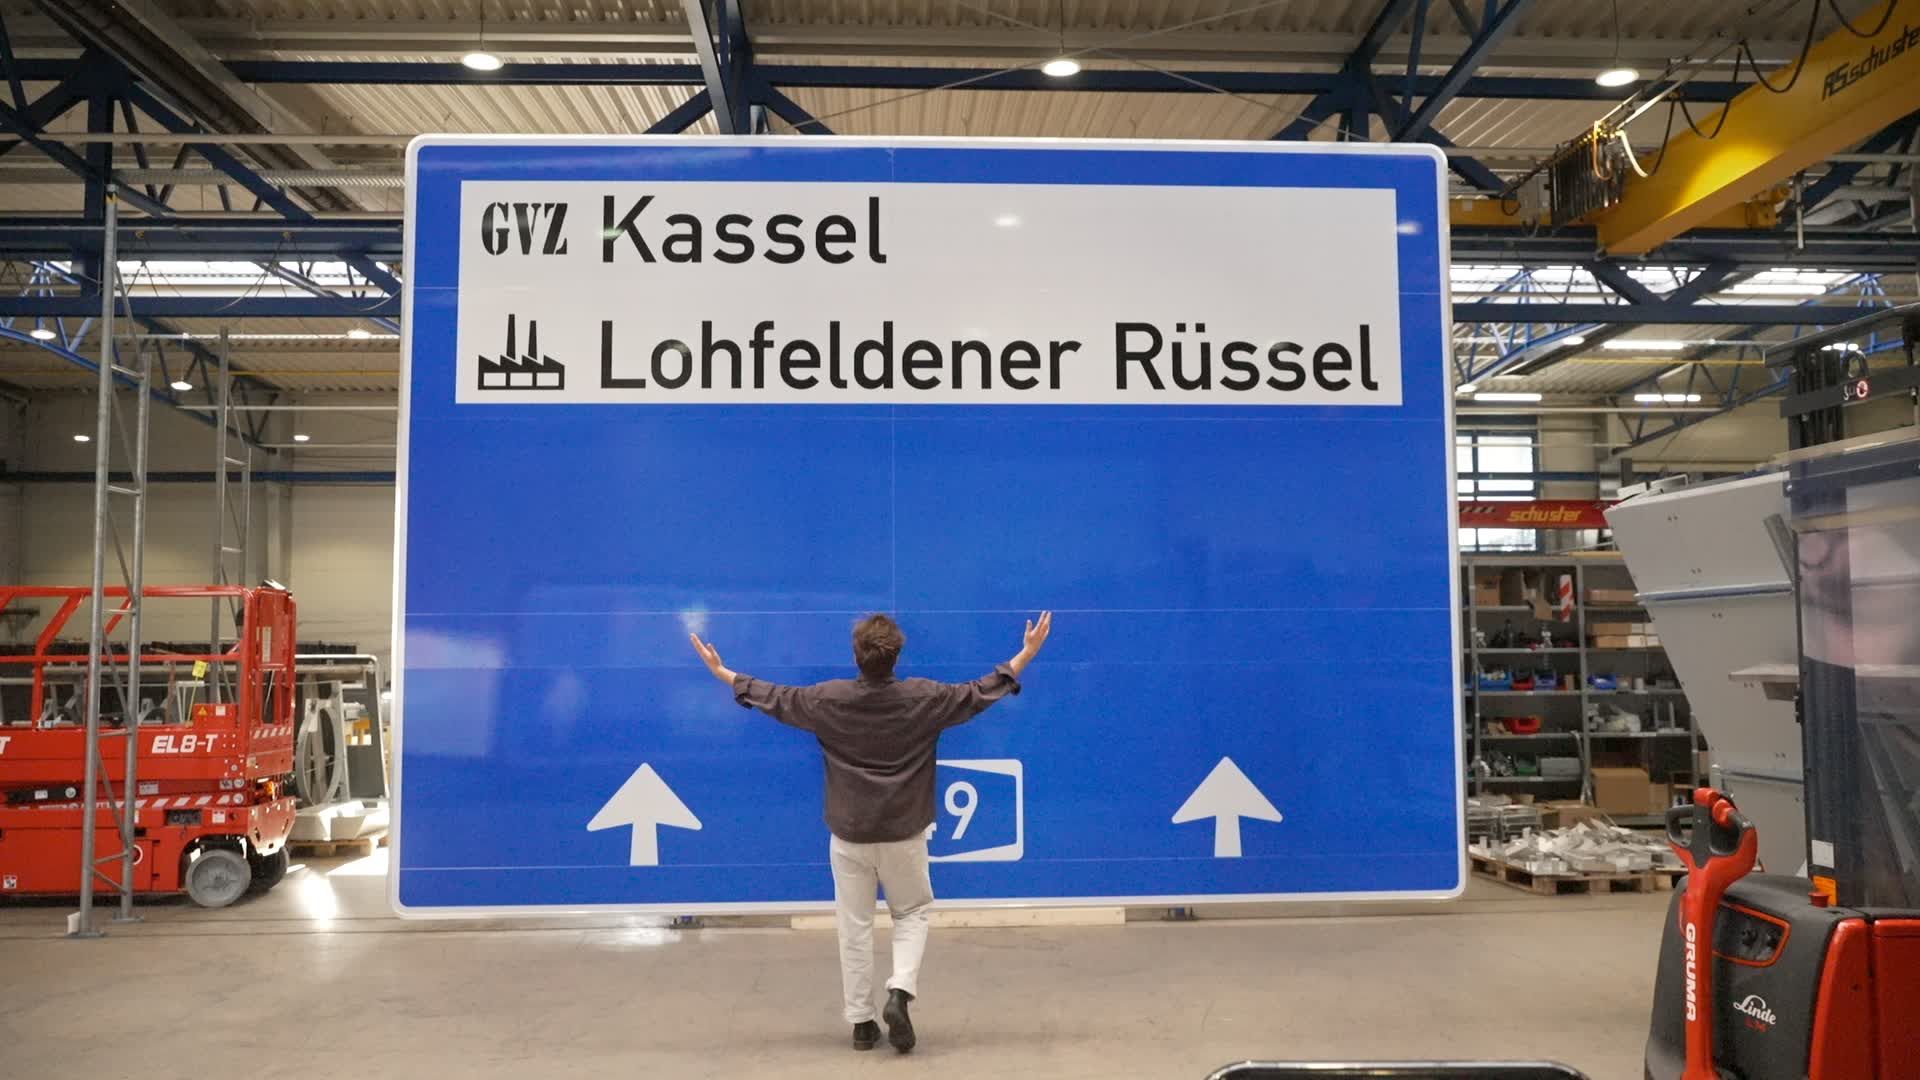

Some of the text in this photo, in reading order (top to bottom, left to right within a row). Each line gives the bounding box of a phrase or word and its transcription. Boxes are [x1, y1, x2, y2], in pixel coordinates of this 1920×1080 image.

[481, 195, 887, 264] GVZ Kassel
[600, 320, 1378, 391] Lohfeldener Rüssel
[1506, 505, 1582, 521] schuster
[926, 781, 978, 840] 9
[1685, 922, 1697, 1021] GRUMA
[1733, 994, 1776, 1025] Linde
